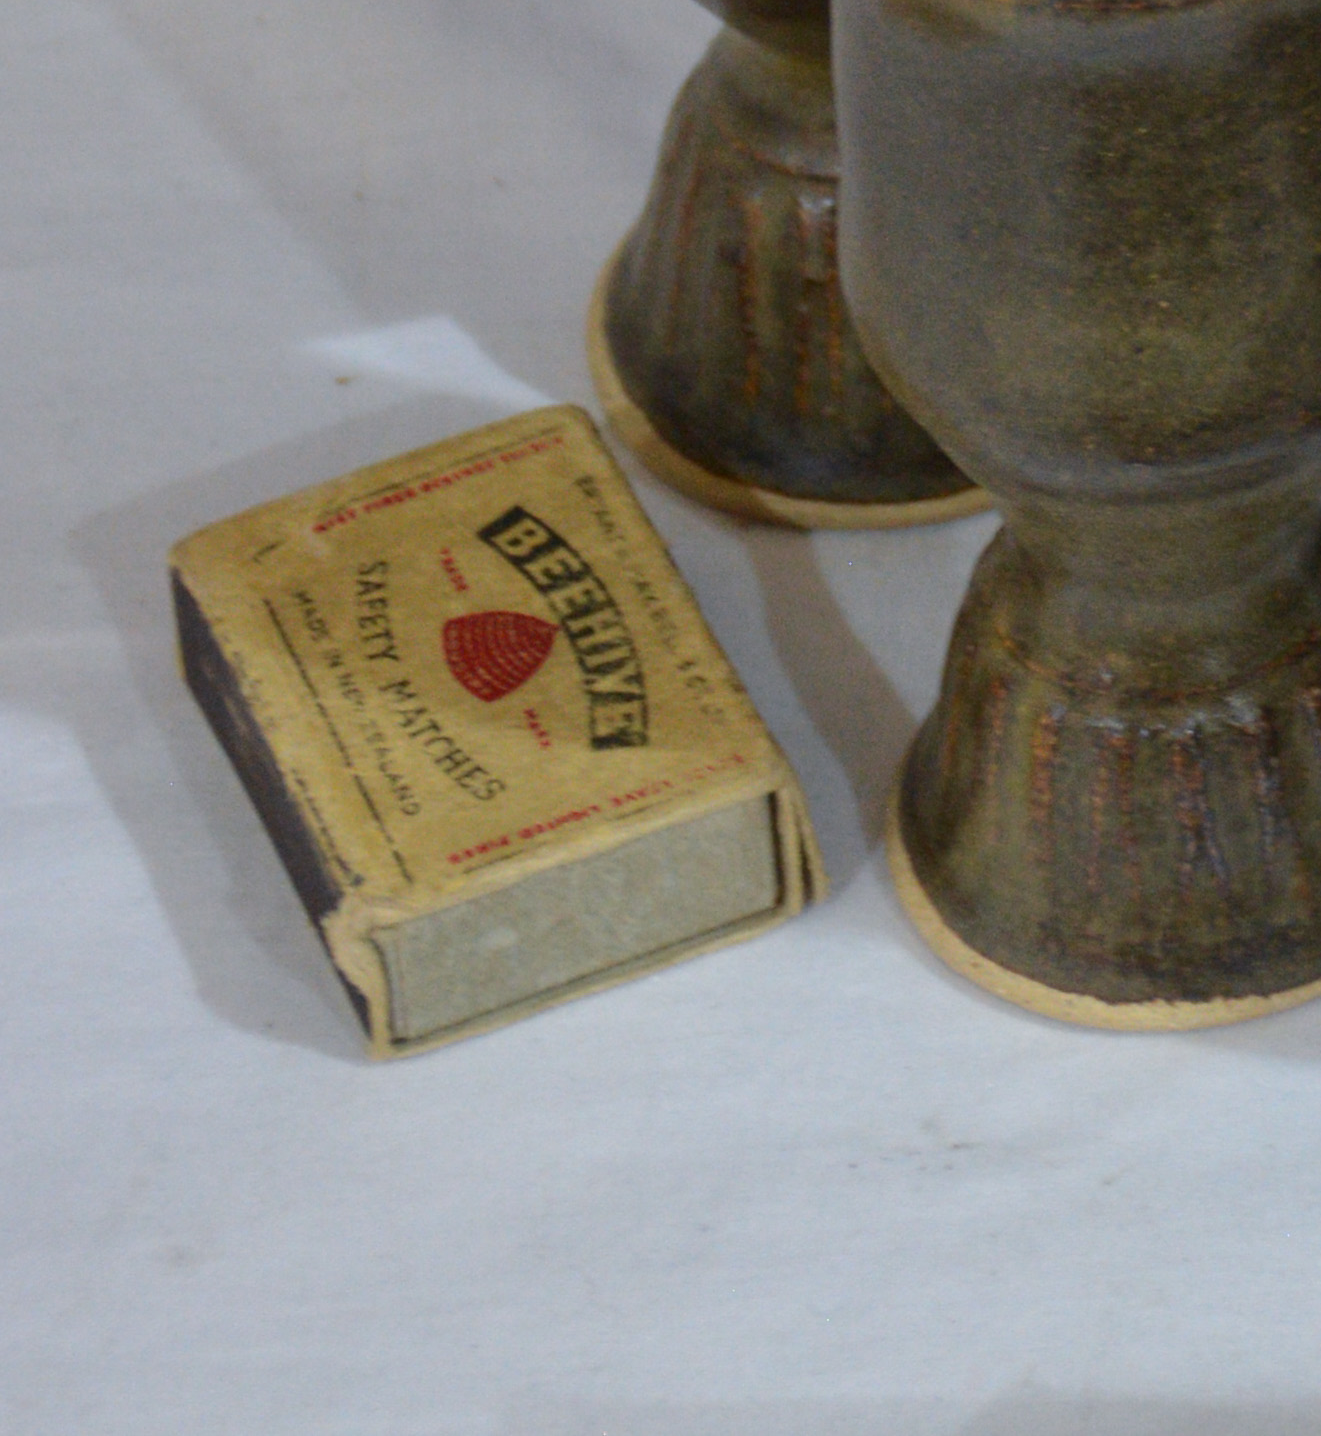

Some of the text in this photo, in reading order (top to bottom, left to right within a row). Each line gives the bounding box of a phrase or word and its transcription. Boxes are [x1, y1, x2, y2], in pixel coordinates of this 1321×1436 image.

[355, 559, 507, 803] SAFETY MATCHES
[484, 511, 648, 745] BEEHIVE
